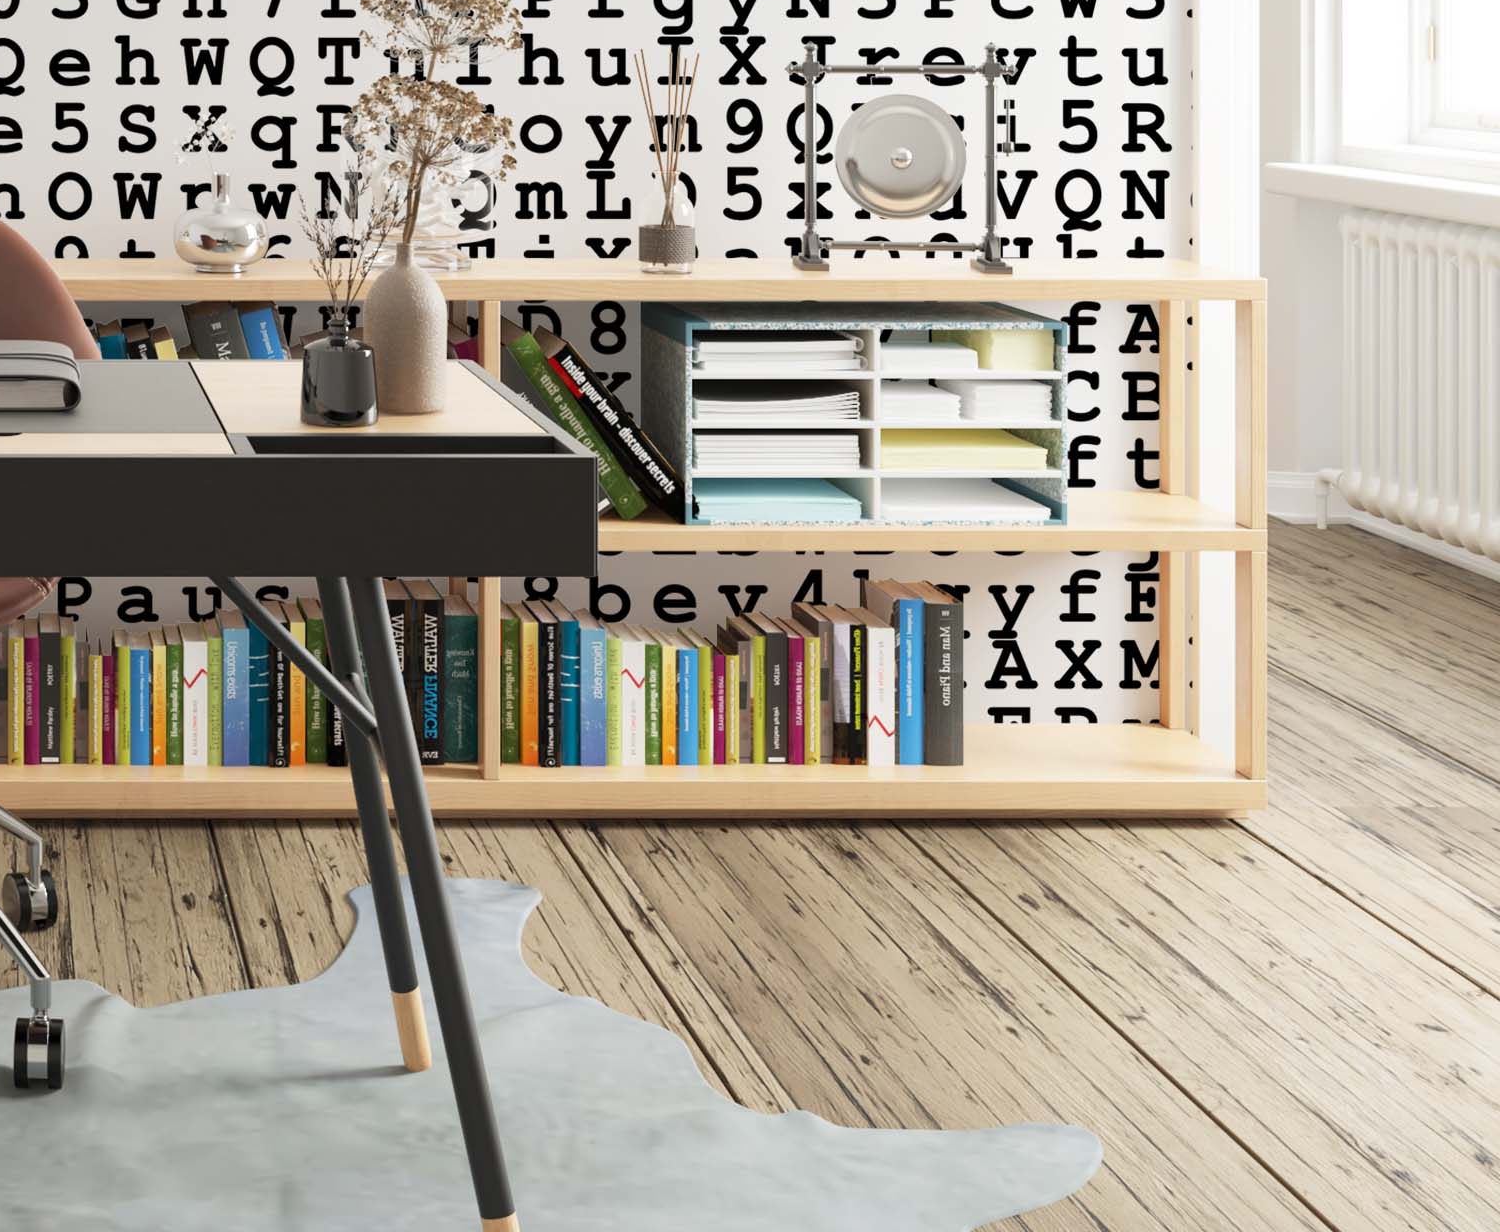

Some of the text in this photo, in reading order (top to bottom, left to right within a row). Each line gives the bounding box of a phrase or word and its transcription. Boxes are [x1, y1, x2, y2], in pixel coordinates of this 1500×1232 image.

[560, 355, 584, 390] Inside
[579, 380, 603, 409] your
[596, 398, 619, 428] brain
[618, 427, 649, 464] discover
[646, 458, 676, 495] secrets
